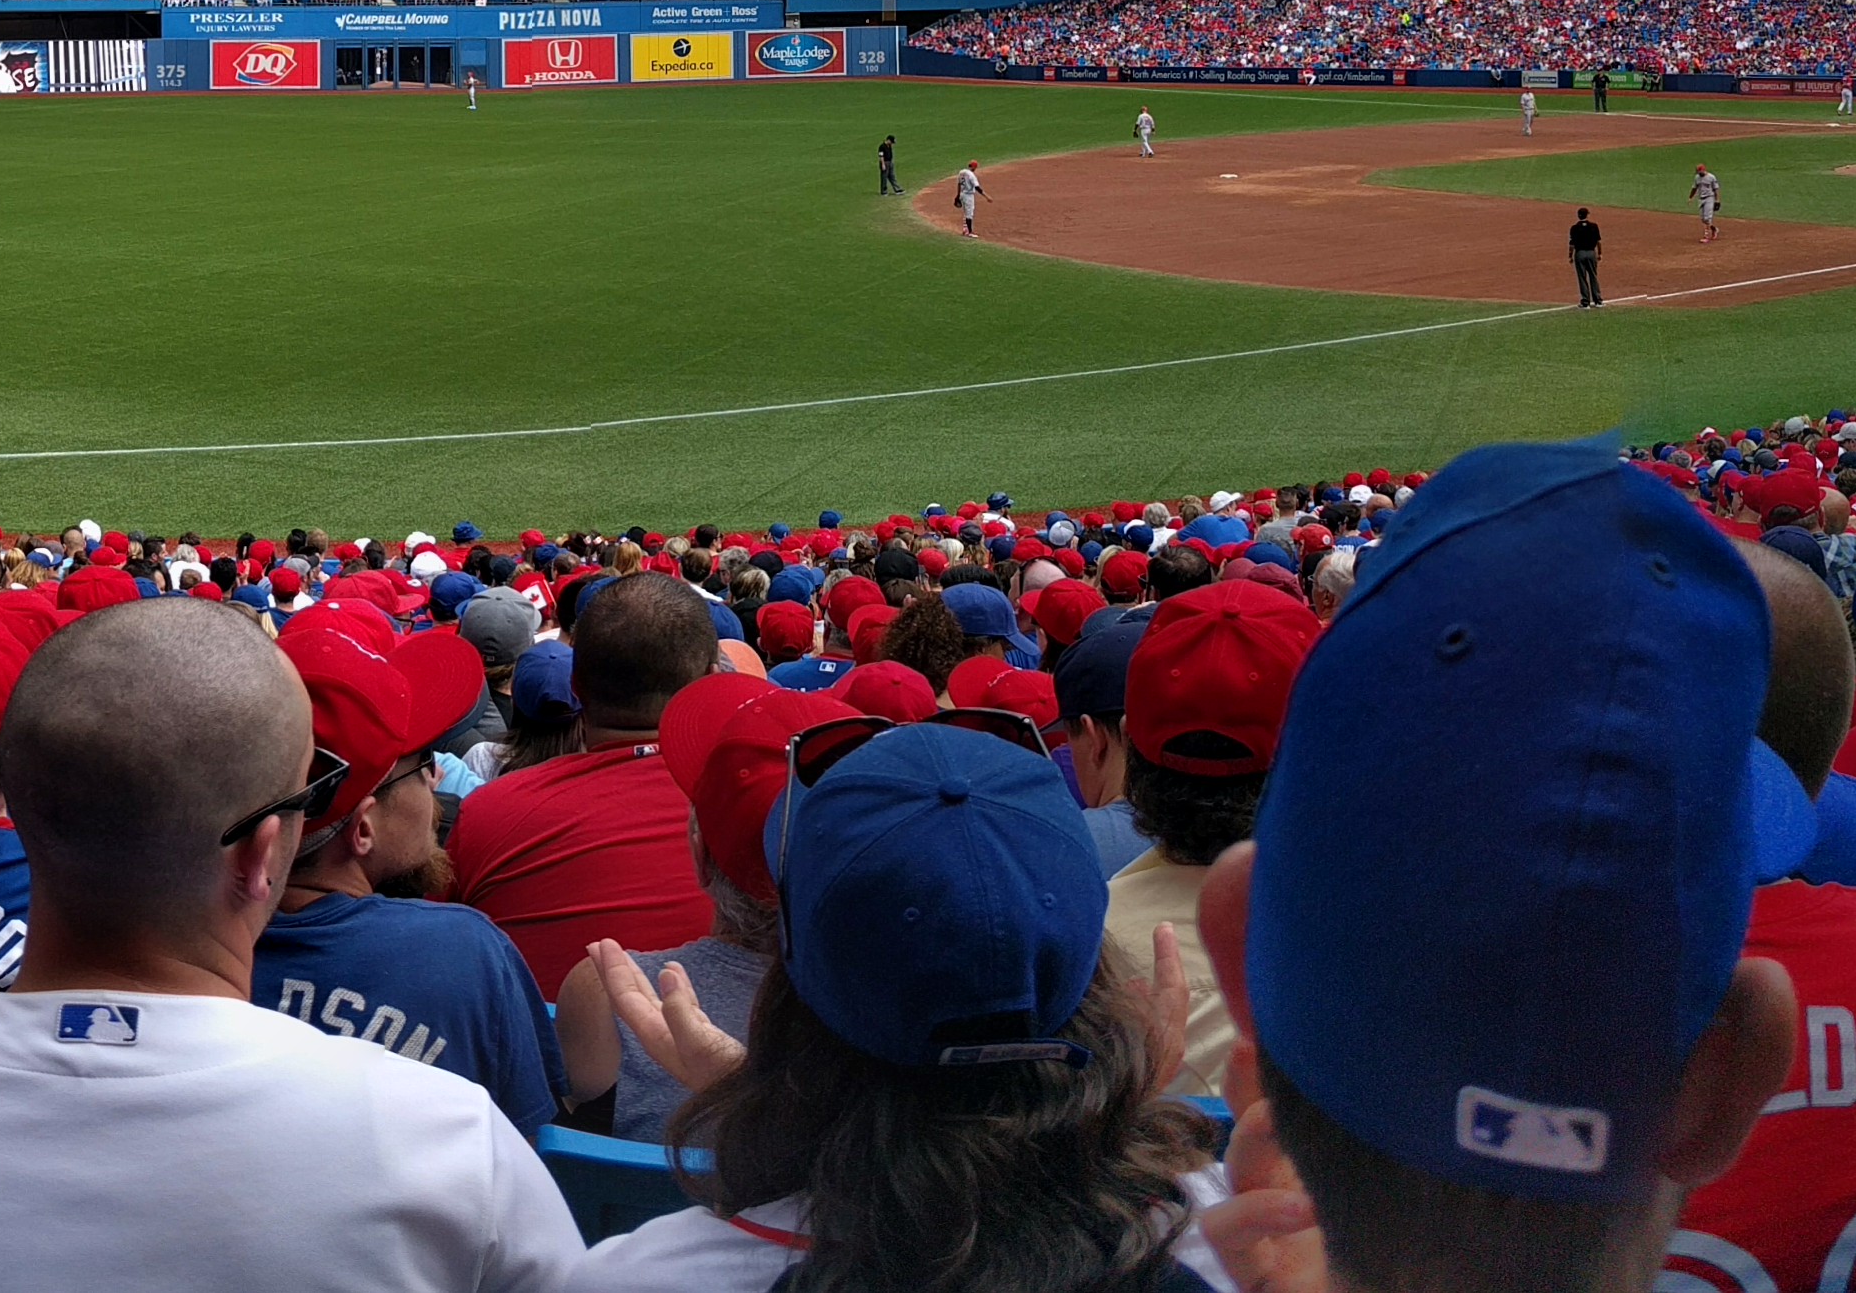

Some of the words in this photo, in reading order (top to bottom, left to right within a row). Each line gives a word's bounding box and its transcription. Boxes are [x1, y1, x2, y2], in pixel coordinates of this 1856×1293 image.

[653, 7, 687, 17] Active
[190, 13, 283, 23] PRESZLER
[561, 9, 601, 27] NOVA
[196, 25, 229, 33] INJURY
[245, 53, 286, 73] DQ
[785, 58, 808, 67] FARMS
[859, 52, 885, 63] 328
[157, 65, 185, 77] 375
[651, 60, 713, 74] Expedia.ca
[1061, 69, 1097, 78] Timberline
[1151, 70, 1187, 79] America's
[1227, 71, 1255, 83] Roofing
[1257, 72, 1289, 83] Shingles
[1318, 72, 1385, 82] gaf.ca/timberline
